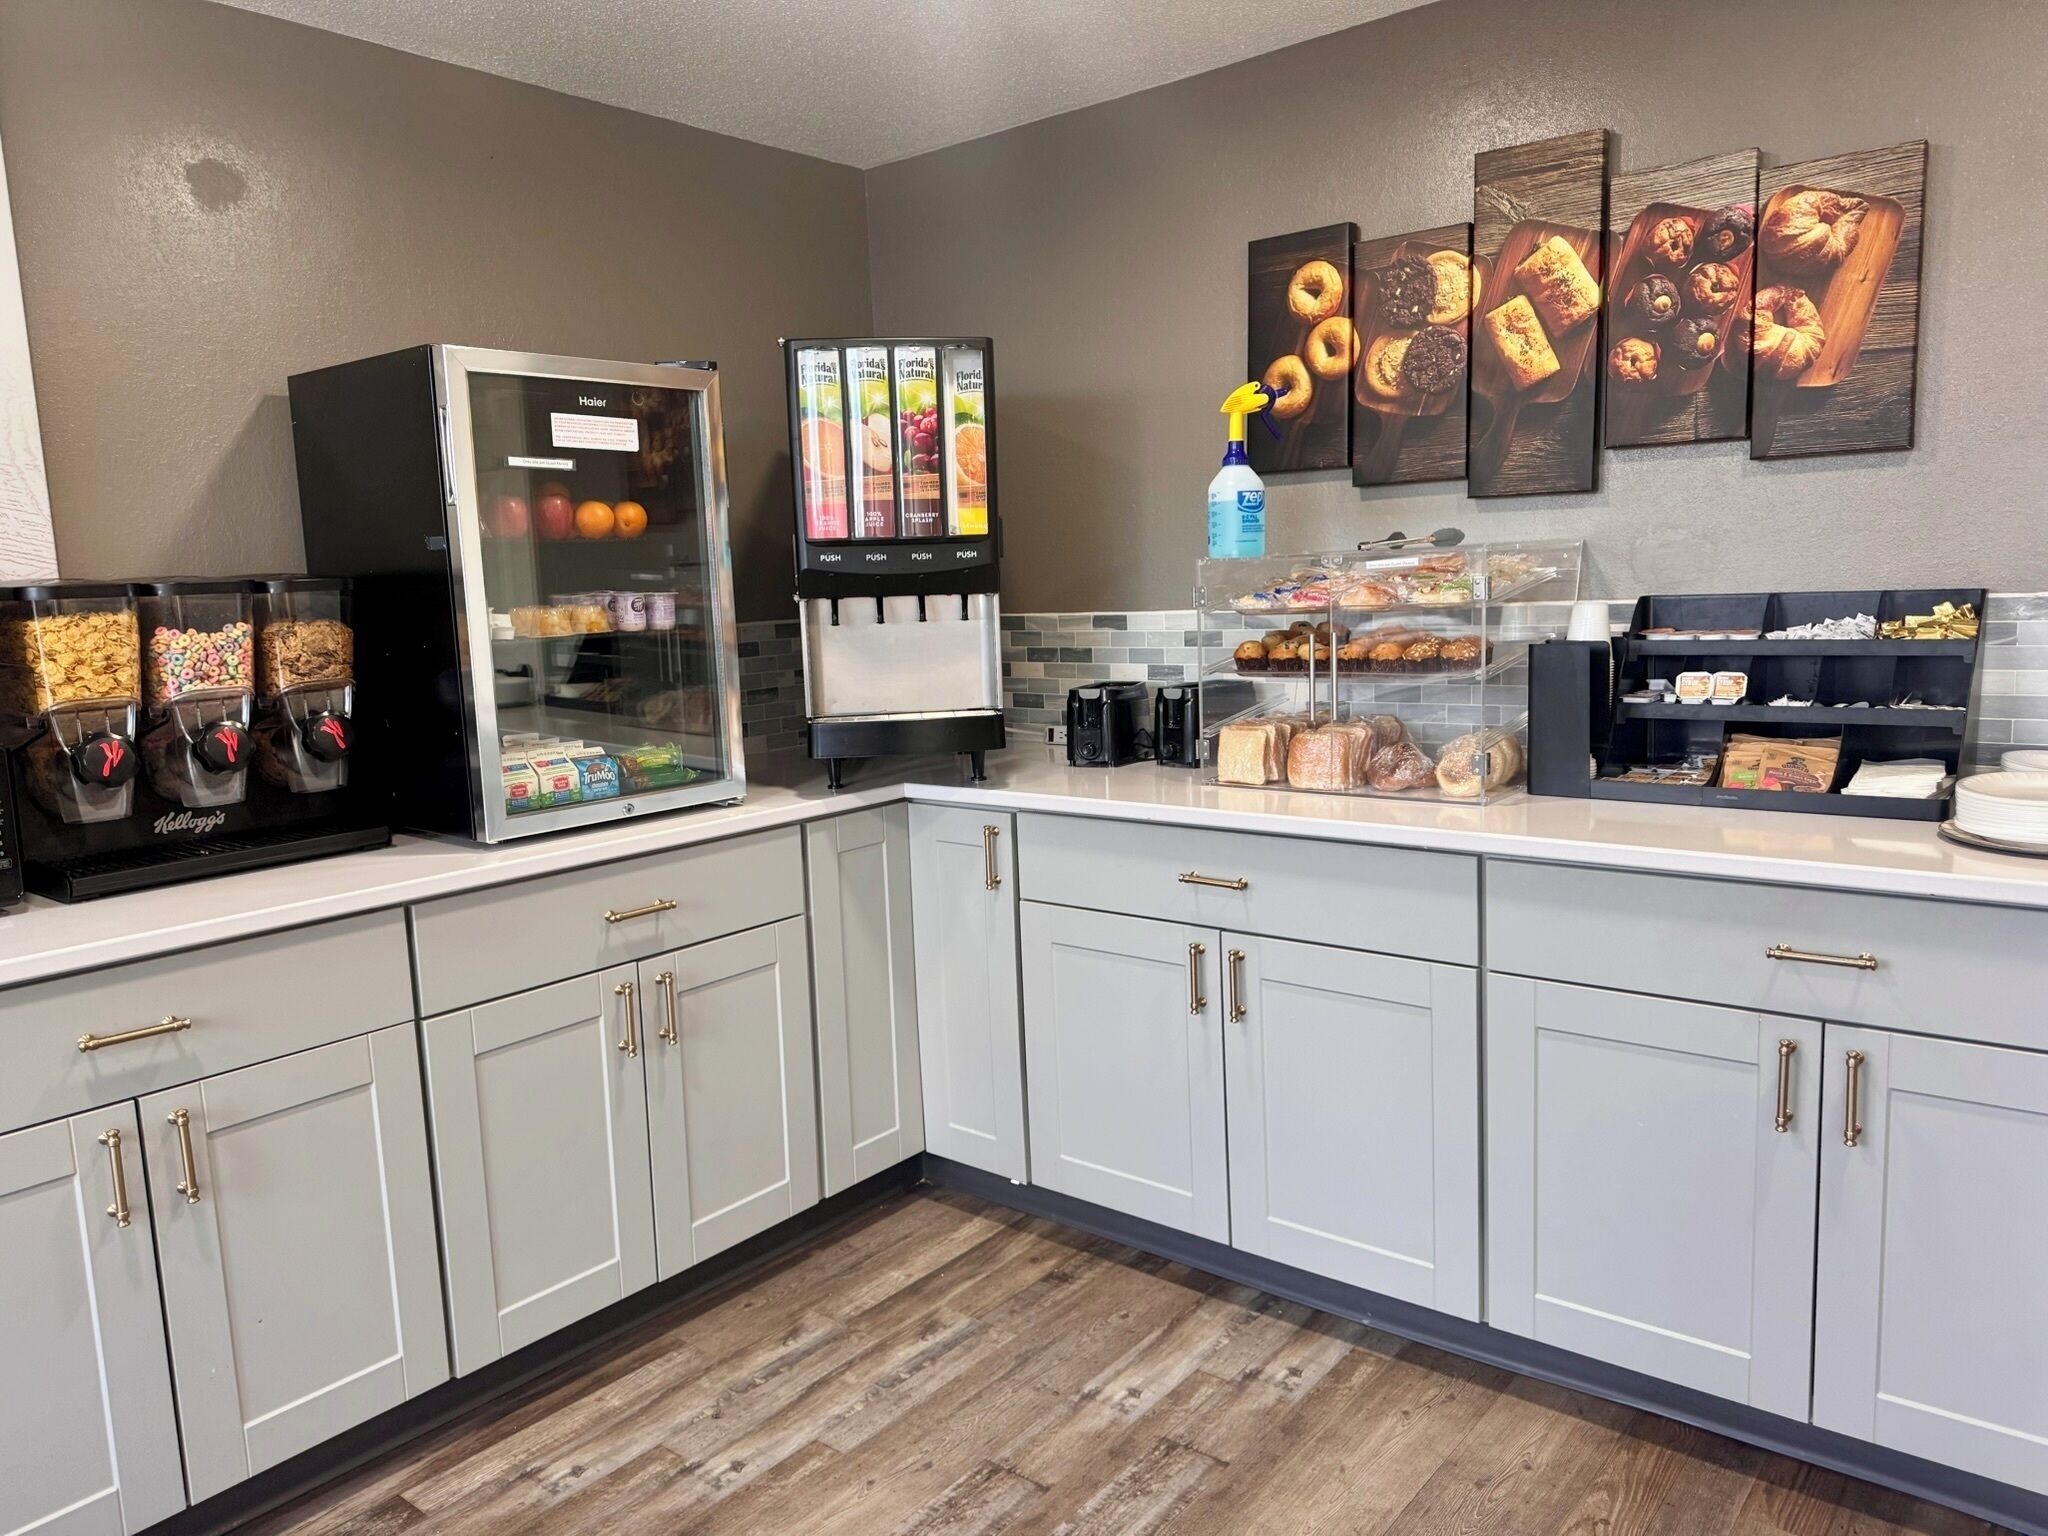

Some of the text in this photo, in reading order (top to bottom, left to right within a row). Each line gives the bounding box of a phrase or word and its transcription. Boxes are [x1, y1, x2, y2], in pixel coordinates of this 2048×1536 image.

[898, 357, 934, 370] Florida's
[899, 369, 934, 379] Natural
[956, 369, 982, 381] Florid
[579, 396, 607, 408] Haier
[820, 554, 841, 562] PUSH
[866, 553, 887, 561] PUSH
[911, 552, 932, 560] PUSH
[956, 551, 977, 559] PUSH
[583, 771, 616, 784] TruMoo
[153, 810, 226, 834] Kellogg's
